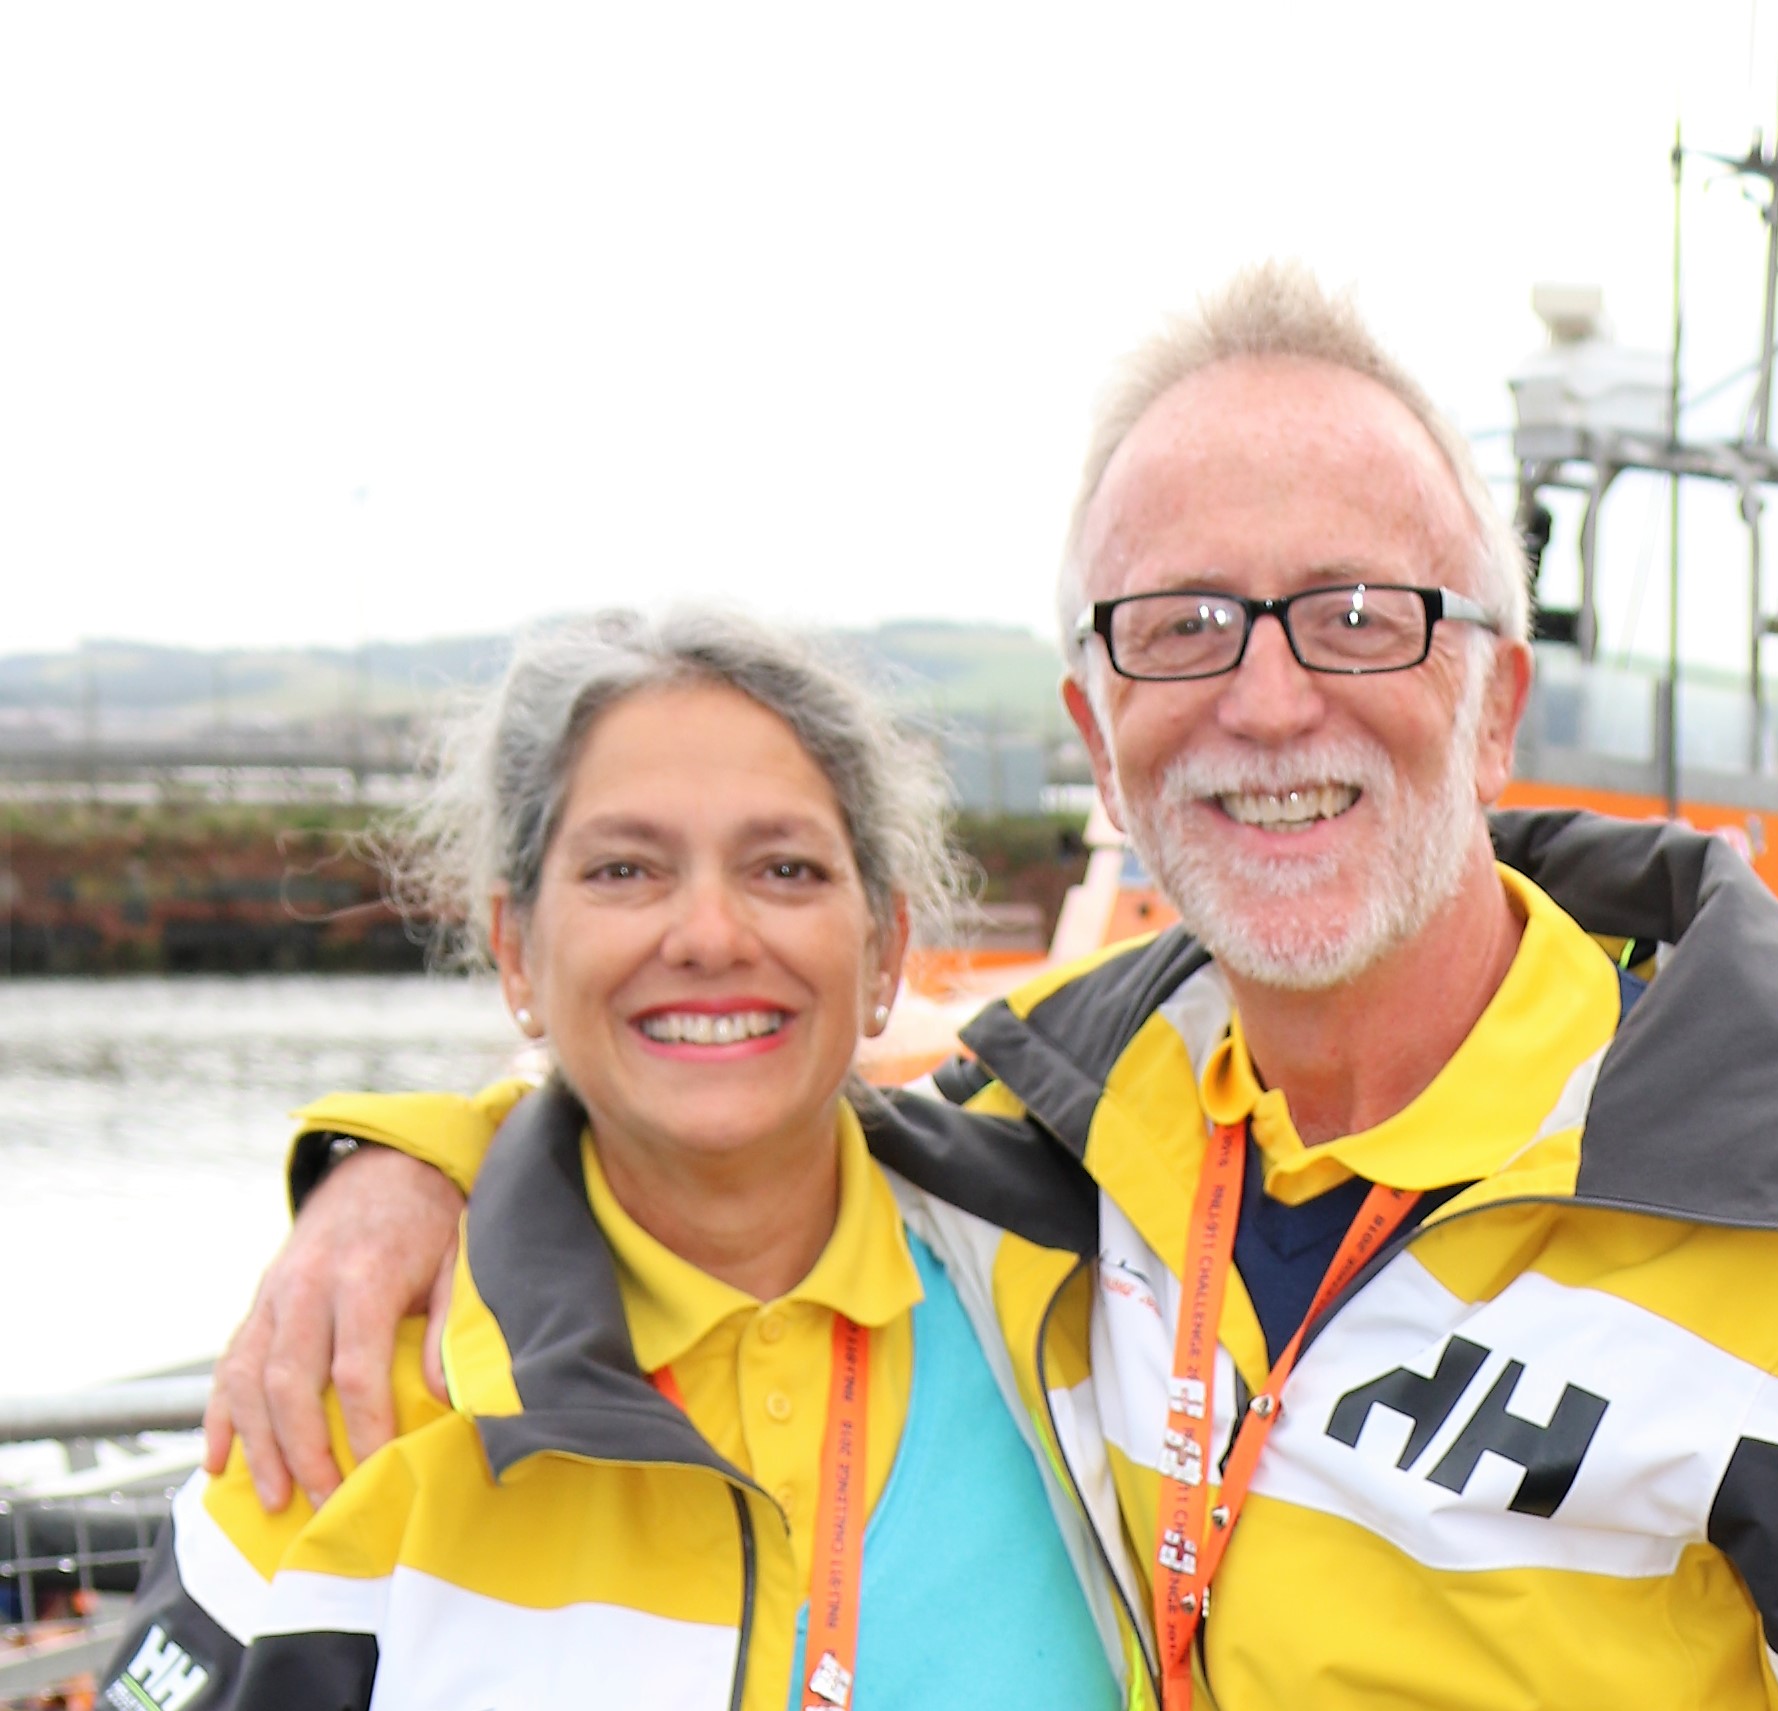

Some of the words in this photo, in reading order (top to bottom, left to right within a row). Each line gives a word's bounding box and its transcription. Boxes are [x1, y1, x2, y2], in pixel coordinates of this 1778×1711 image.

[1188, 1257, 1213, 1357] CHALLENGE
[1325, 1334, 1610, 1518] HH
[832, 1463, 850, 1552] CHALLENGE
